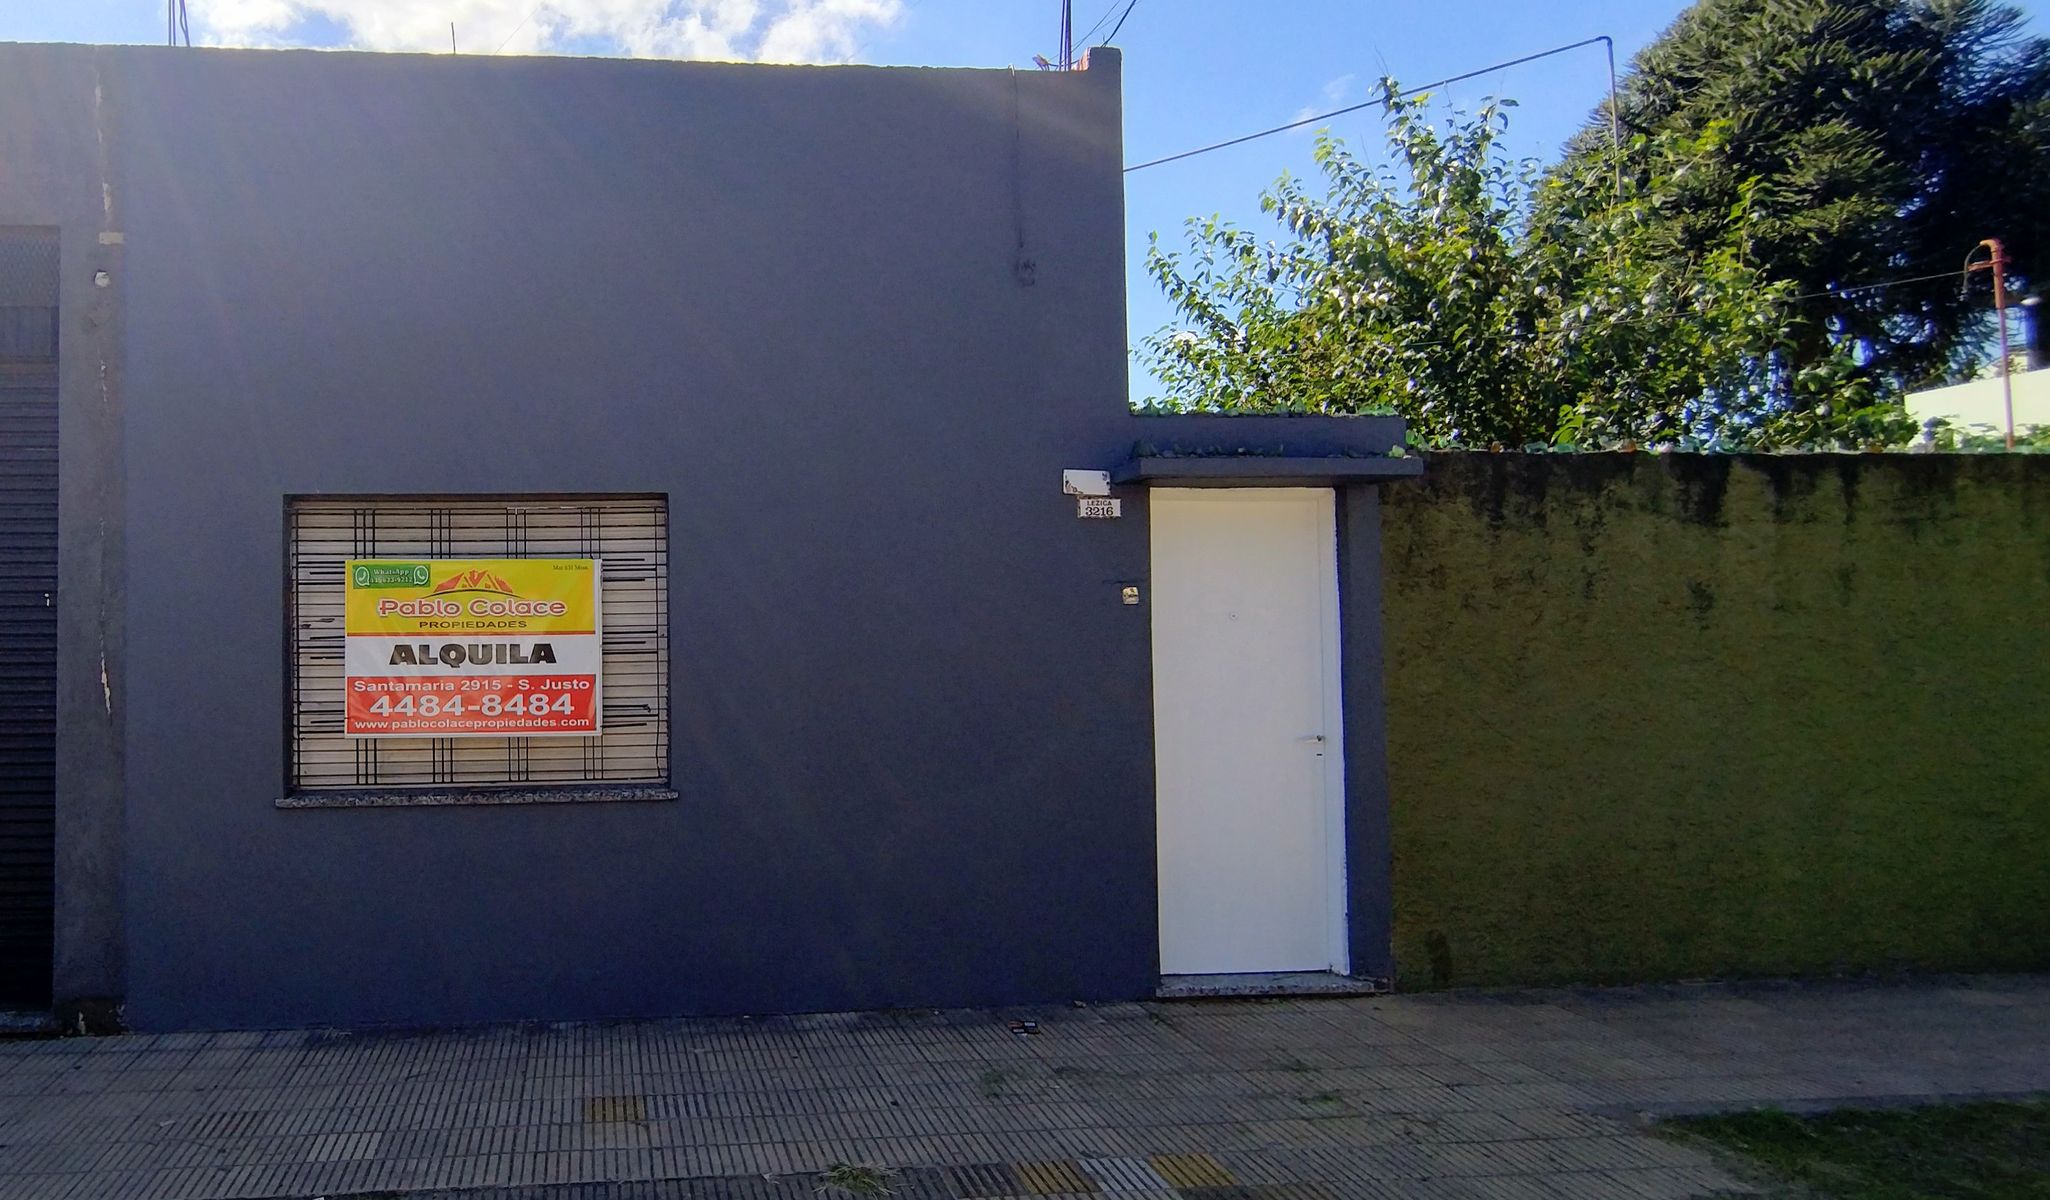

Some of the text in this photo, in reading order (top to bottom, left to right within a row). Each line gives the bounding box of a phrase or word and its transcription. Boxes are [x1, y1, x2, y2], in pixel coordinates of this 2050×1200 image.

[1085, 506, 1114, 516] 3216
[373, 568, 410, 576] WhatsApp
[378, 598, 568, 618] Pablo Colace
[419, 620, 527, 629] PROPIEDADES
[389, 643, 557, 668] ALQUILA
[354, 680, 455, 692] Santamaria
[460, 679, 502, 691] 2915
[517, 679, 535, 691] S.
[540, 678, 590, 690] Justo
[369, 693, 575, 717] 4484-8484
[354, 718, 590, 731] www.pablocolacepropiedades.com
